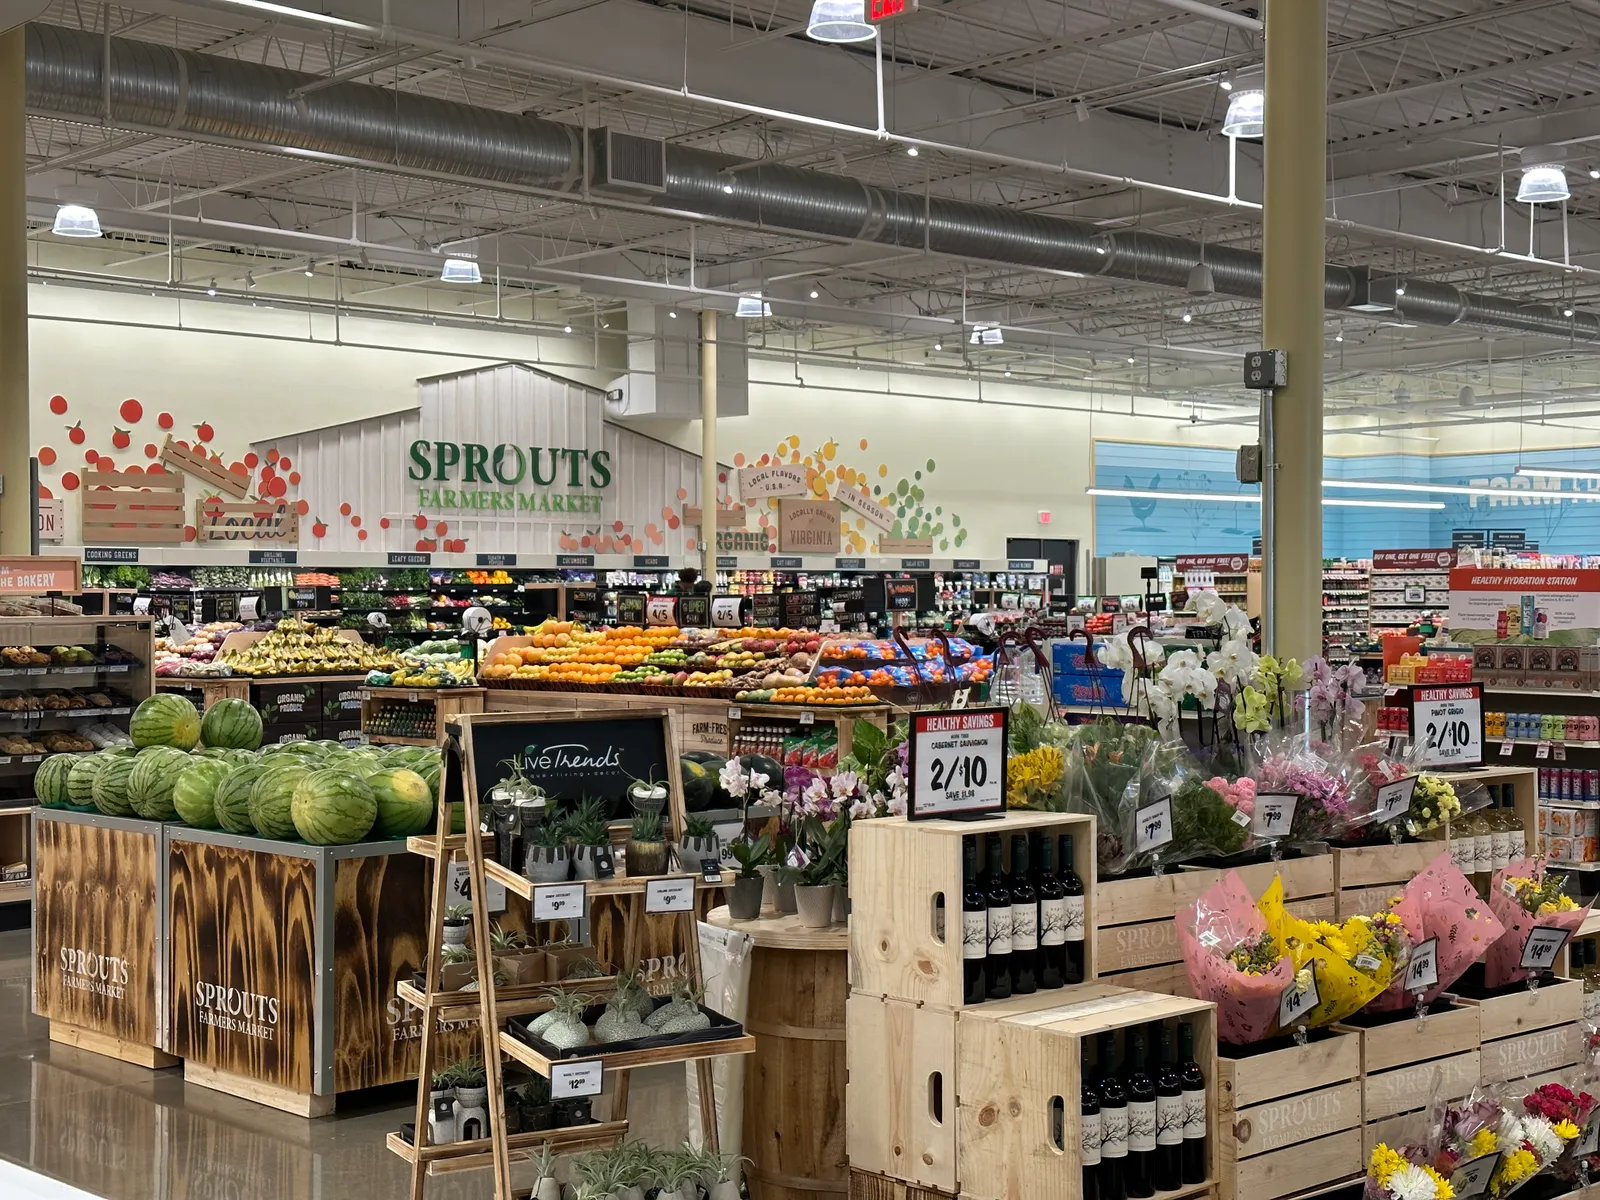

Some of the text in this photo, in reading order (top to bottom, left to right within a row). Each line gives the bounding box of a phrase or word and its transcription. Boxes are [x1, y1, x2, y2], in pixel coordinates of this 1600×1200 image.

[408, 440, 612, 489] SPROUTS
[748, 470, 801, 488] LOCAL FLAVORS
[418, 488, 603, 513] FARMERS MARKET
[848, 493, 884, 520] IN SEASON
[208, 504, 287, 541] Local
[789, 508, 836, 524] LOCALLY GROWN
[716, 532, 769, 550] RGANIC
[790, 530, 833, 546] VIRGINIA
[86, 551, 137, 559] COOKING GREENS
[0, 572, 55, 587] HE BAKERY
[1471, 577, 1578, 585] HEALTHY HYDRATION STATION
[277, 693, 305, 705] ORGANIC
[338, 691, 362, 701] ORGANI
[1421, 687, 1473, 700] HEALTHY SAVINGS
[279, 702, 303, 712] PRODUCE
[692, 722, 729, 735] FARM-FRES
[926, 714, 994, 731] HEALTHY SAVINGS
[931, 739, 988, 749] CABERNET SAUVIGNON
[513, 744, 620, 770] LiveTrends
[945, 791, 959, 799] SAVE
[1116, 920, 1177, 952] SPROU
[60, 947, 129, 985] SPROUTS
[62, 975, 125, 1000] FARMERS MARKET
[195, 980, 280, 1024] SPROUTS
[198, 1010, 274, 1041] FARMERS MARKET
[1499, 1029, 1568, 1066] SPROUTS
[1259, 1091, 1342, 1135] SPROUTS
